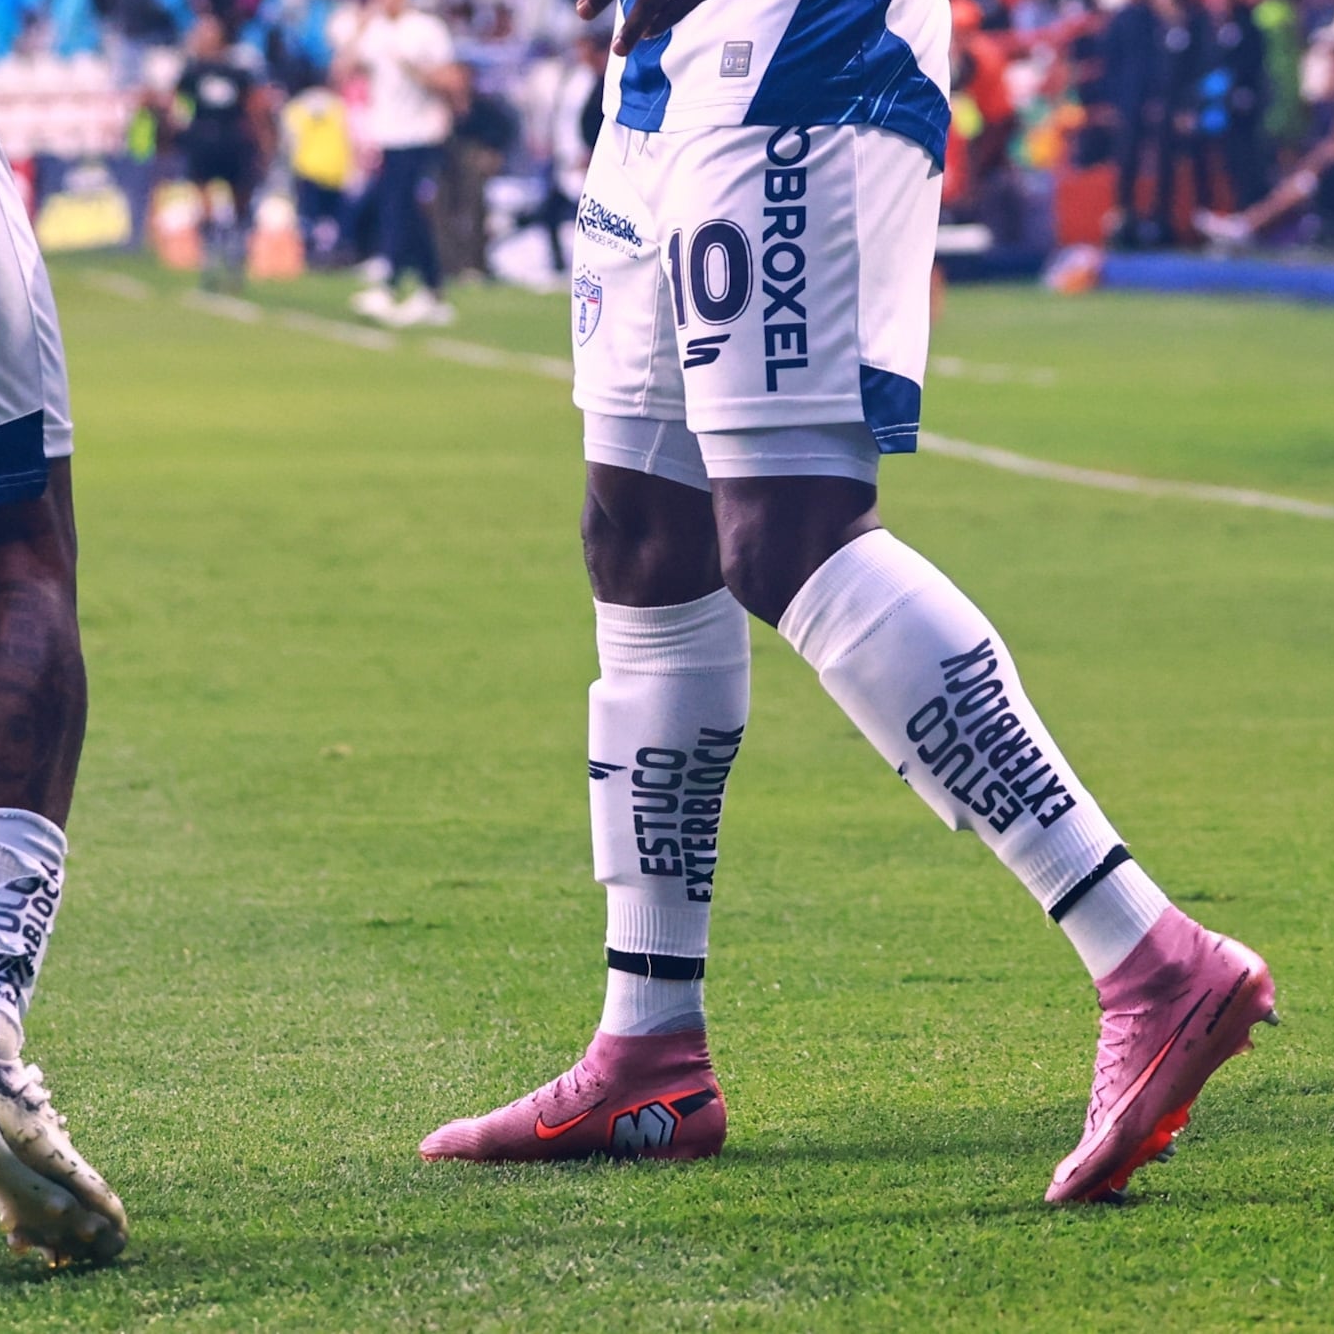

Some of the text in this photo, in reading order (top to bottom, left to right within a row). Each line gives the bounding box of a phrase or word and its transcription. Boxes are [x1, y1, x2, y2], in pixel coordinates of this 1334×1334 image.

[667, 218, 754, 330] 10
[762, 167, 809, 392] BROXEL
[631, 746, 688, 878] ESTUCO
[906, 696, 1024, 834] ESTUCO
[940, 638, 1077, 829] EXTERBLOCK
[680, 724, 746, 904] EXTERBLOCK
